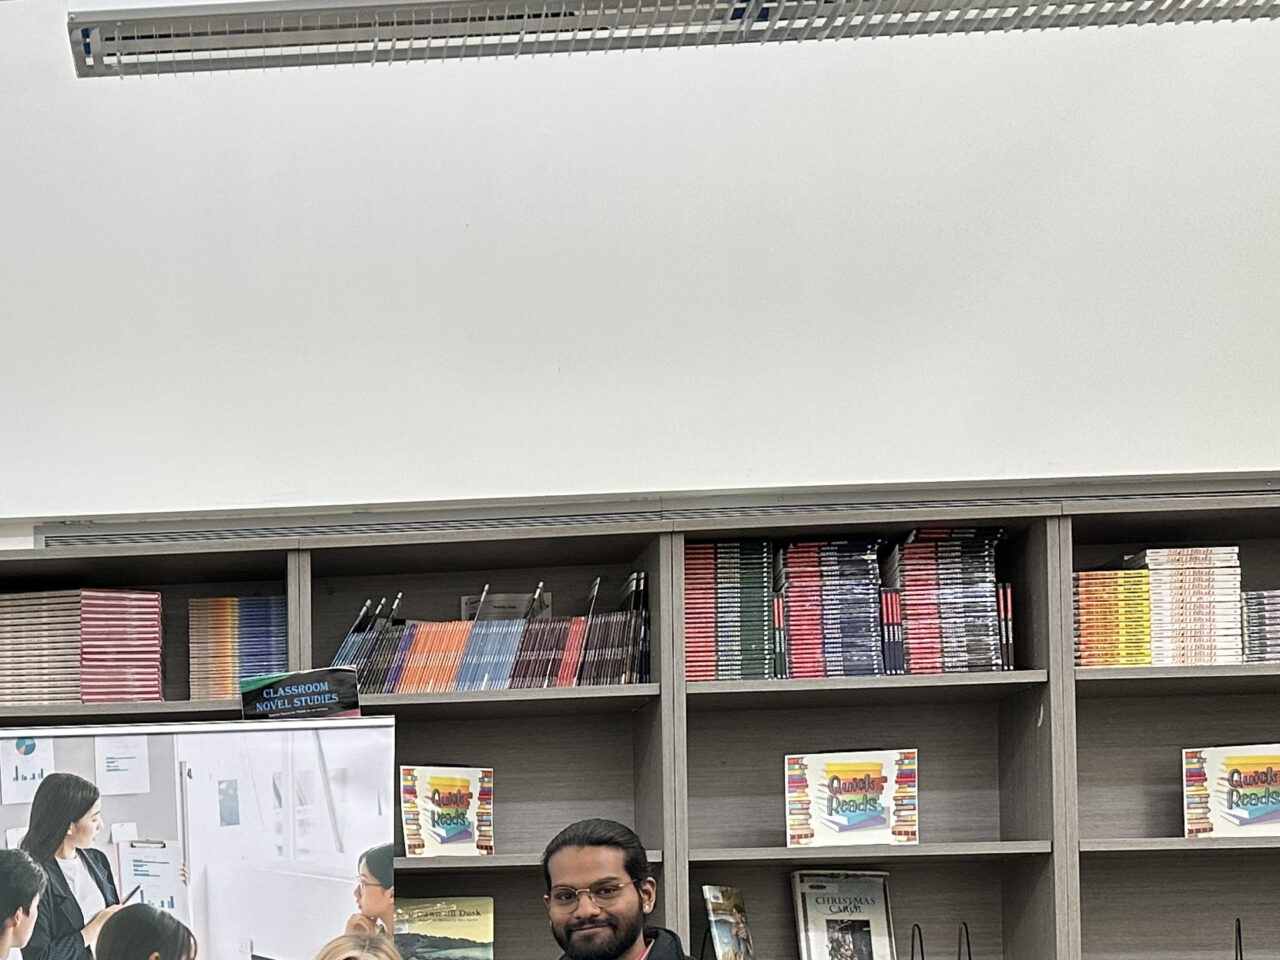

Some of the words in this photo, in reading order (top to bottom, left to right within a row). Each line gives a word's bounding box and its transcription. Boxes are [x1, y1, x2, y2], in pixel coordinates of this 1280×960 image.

[263, 682, 329, 699] CLASSROOM
[256, 699, 292, 712] NOVEL
[293, 693, 339, 707] STUDIES
[828, 774, 875, 795] Quick
[1228, 767, 1278, 789] Quick
[431, 788, 465, 807] Quick
[827, 794, 878, 816] Reads
[815, 896, 876, 905] CHRISTMAS
[459, 909, 482, 917] Dusk
